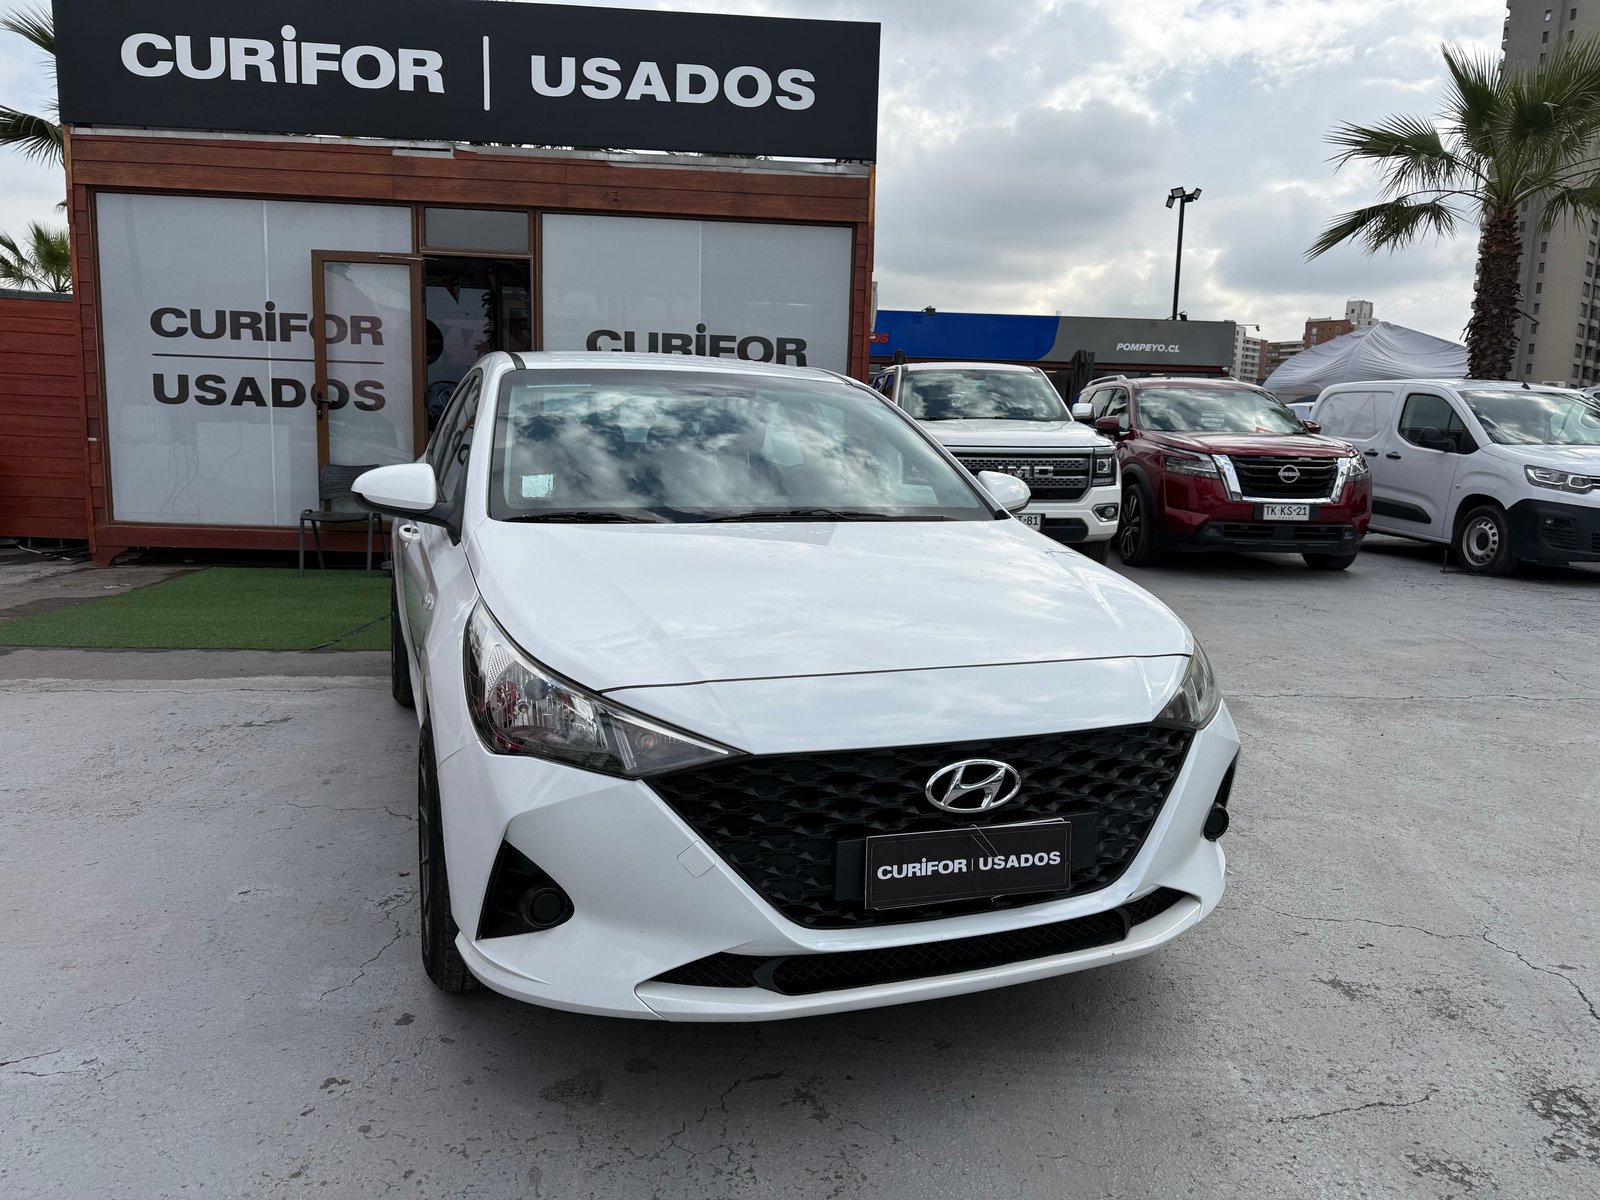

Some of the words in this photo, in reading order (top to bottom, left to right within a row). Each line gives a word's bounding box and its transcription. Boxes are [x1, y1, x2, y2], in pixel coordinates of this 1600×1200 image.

[530, 55, 816, 111] USADOS
[1116, 342, 1180, 353] POMPEYO.CL
[153, 373, 386, 411] USADOS
[978, 851, 1061, 871] USADOS
